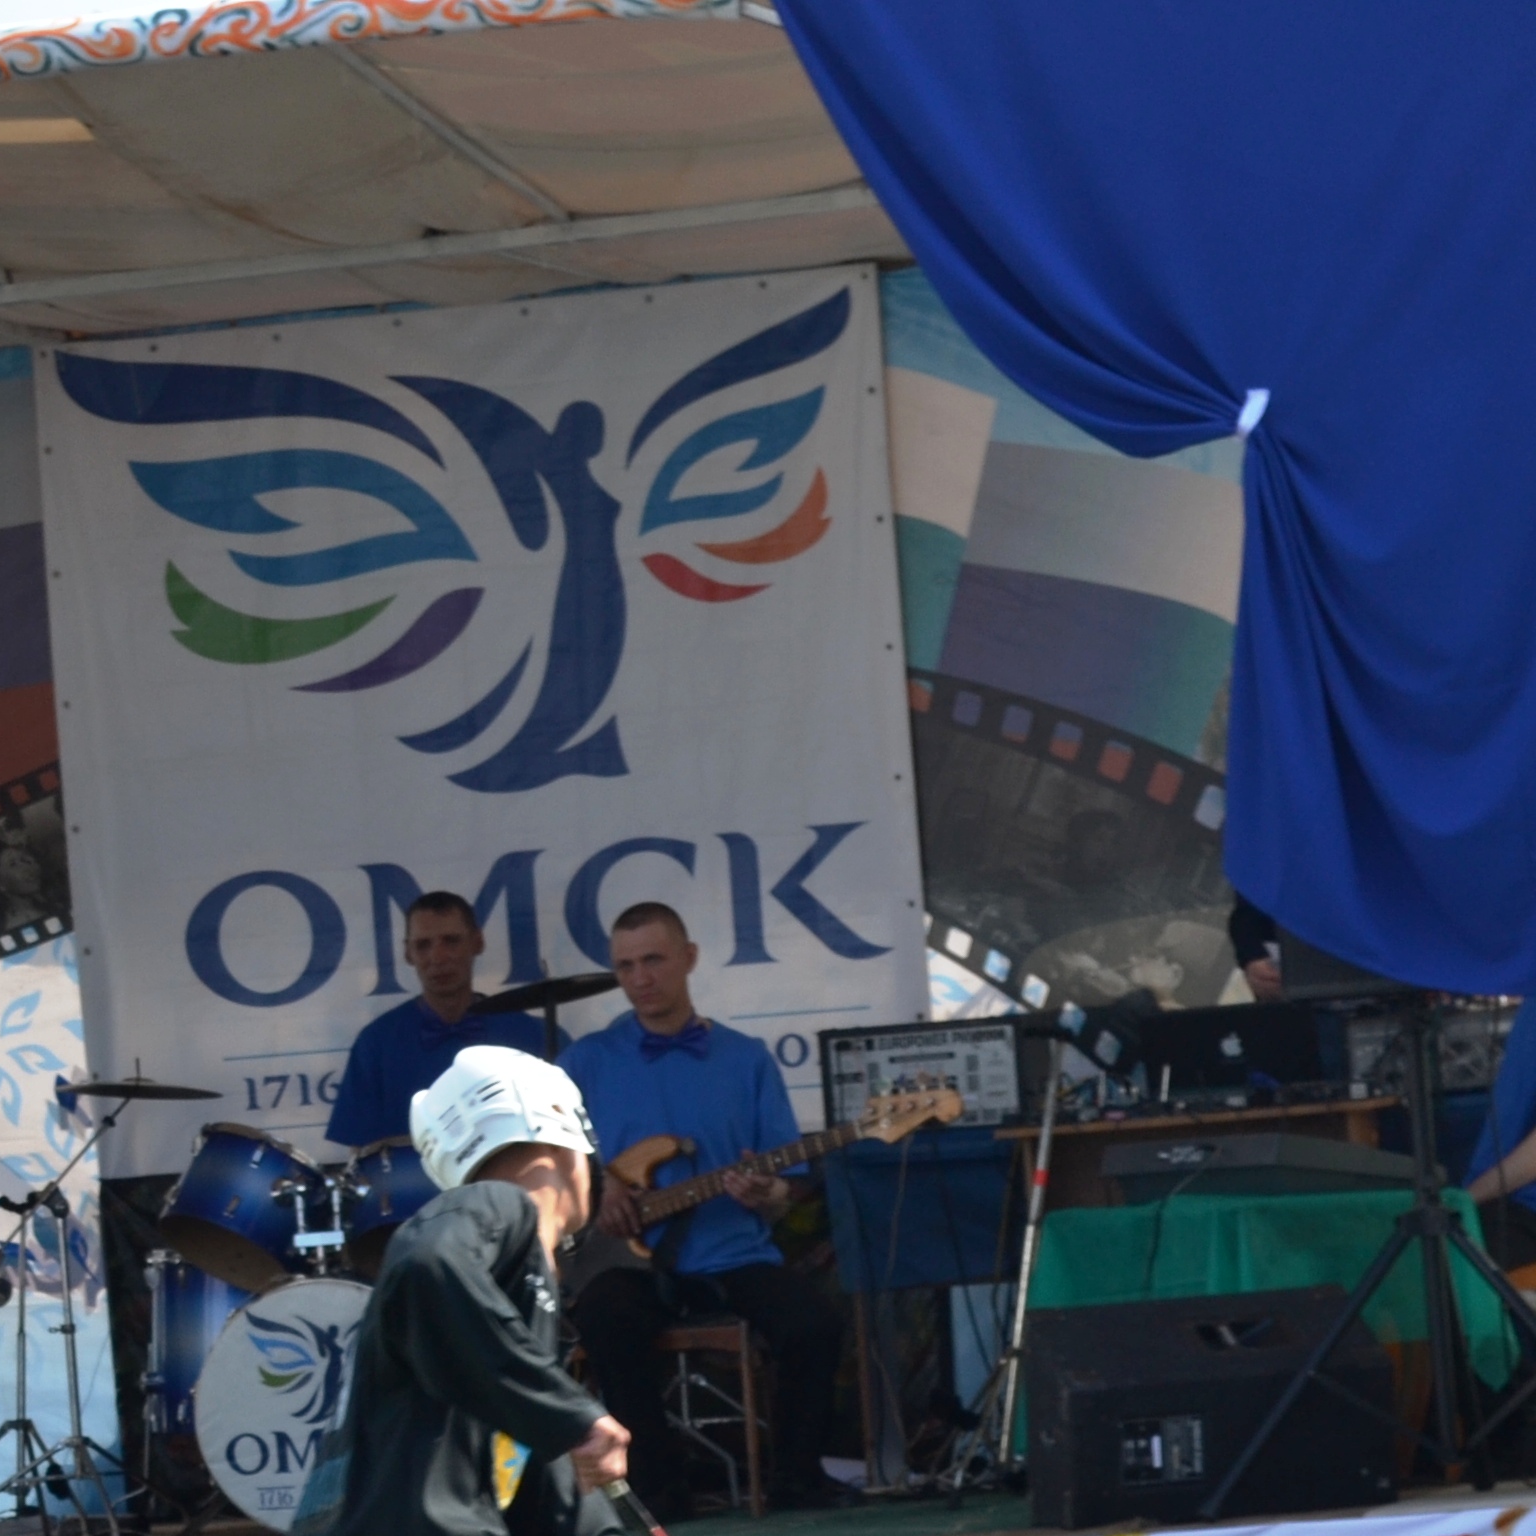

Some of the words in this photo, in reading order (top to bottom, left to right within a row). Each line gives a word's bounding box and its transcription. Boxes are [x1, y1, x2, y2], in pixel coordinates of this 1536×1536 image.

[184, 821, 894, 1009] ОМСК
[244, 1069, 340, 1111] 1716
[225, 1429, 326, 1476] ОМ
